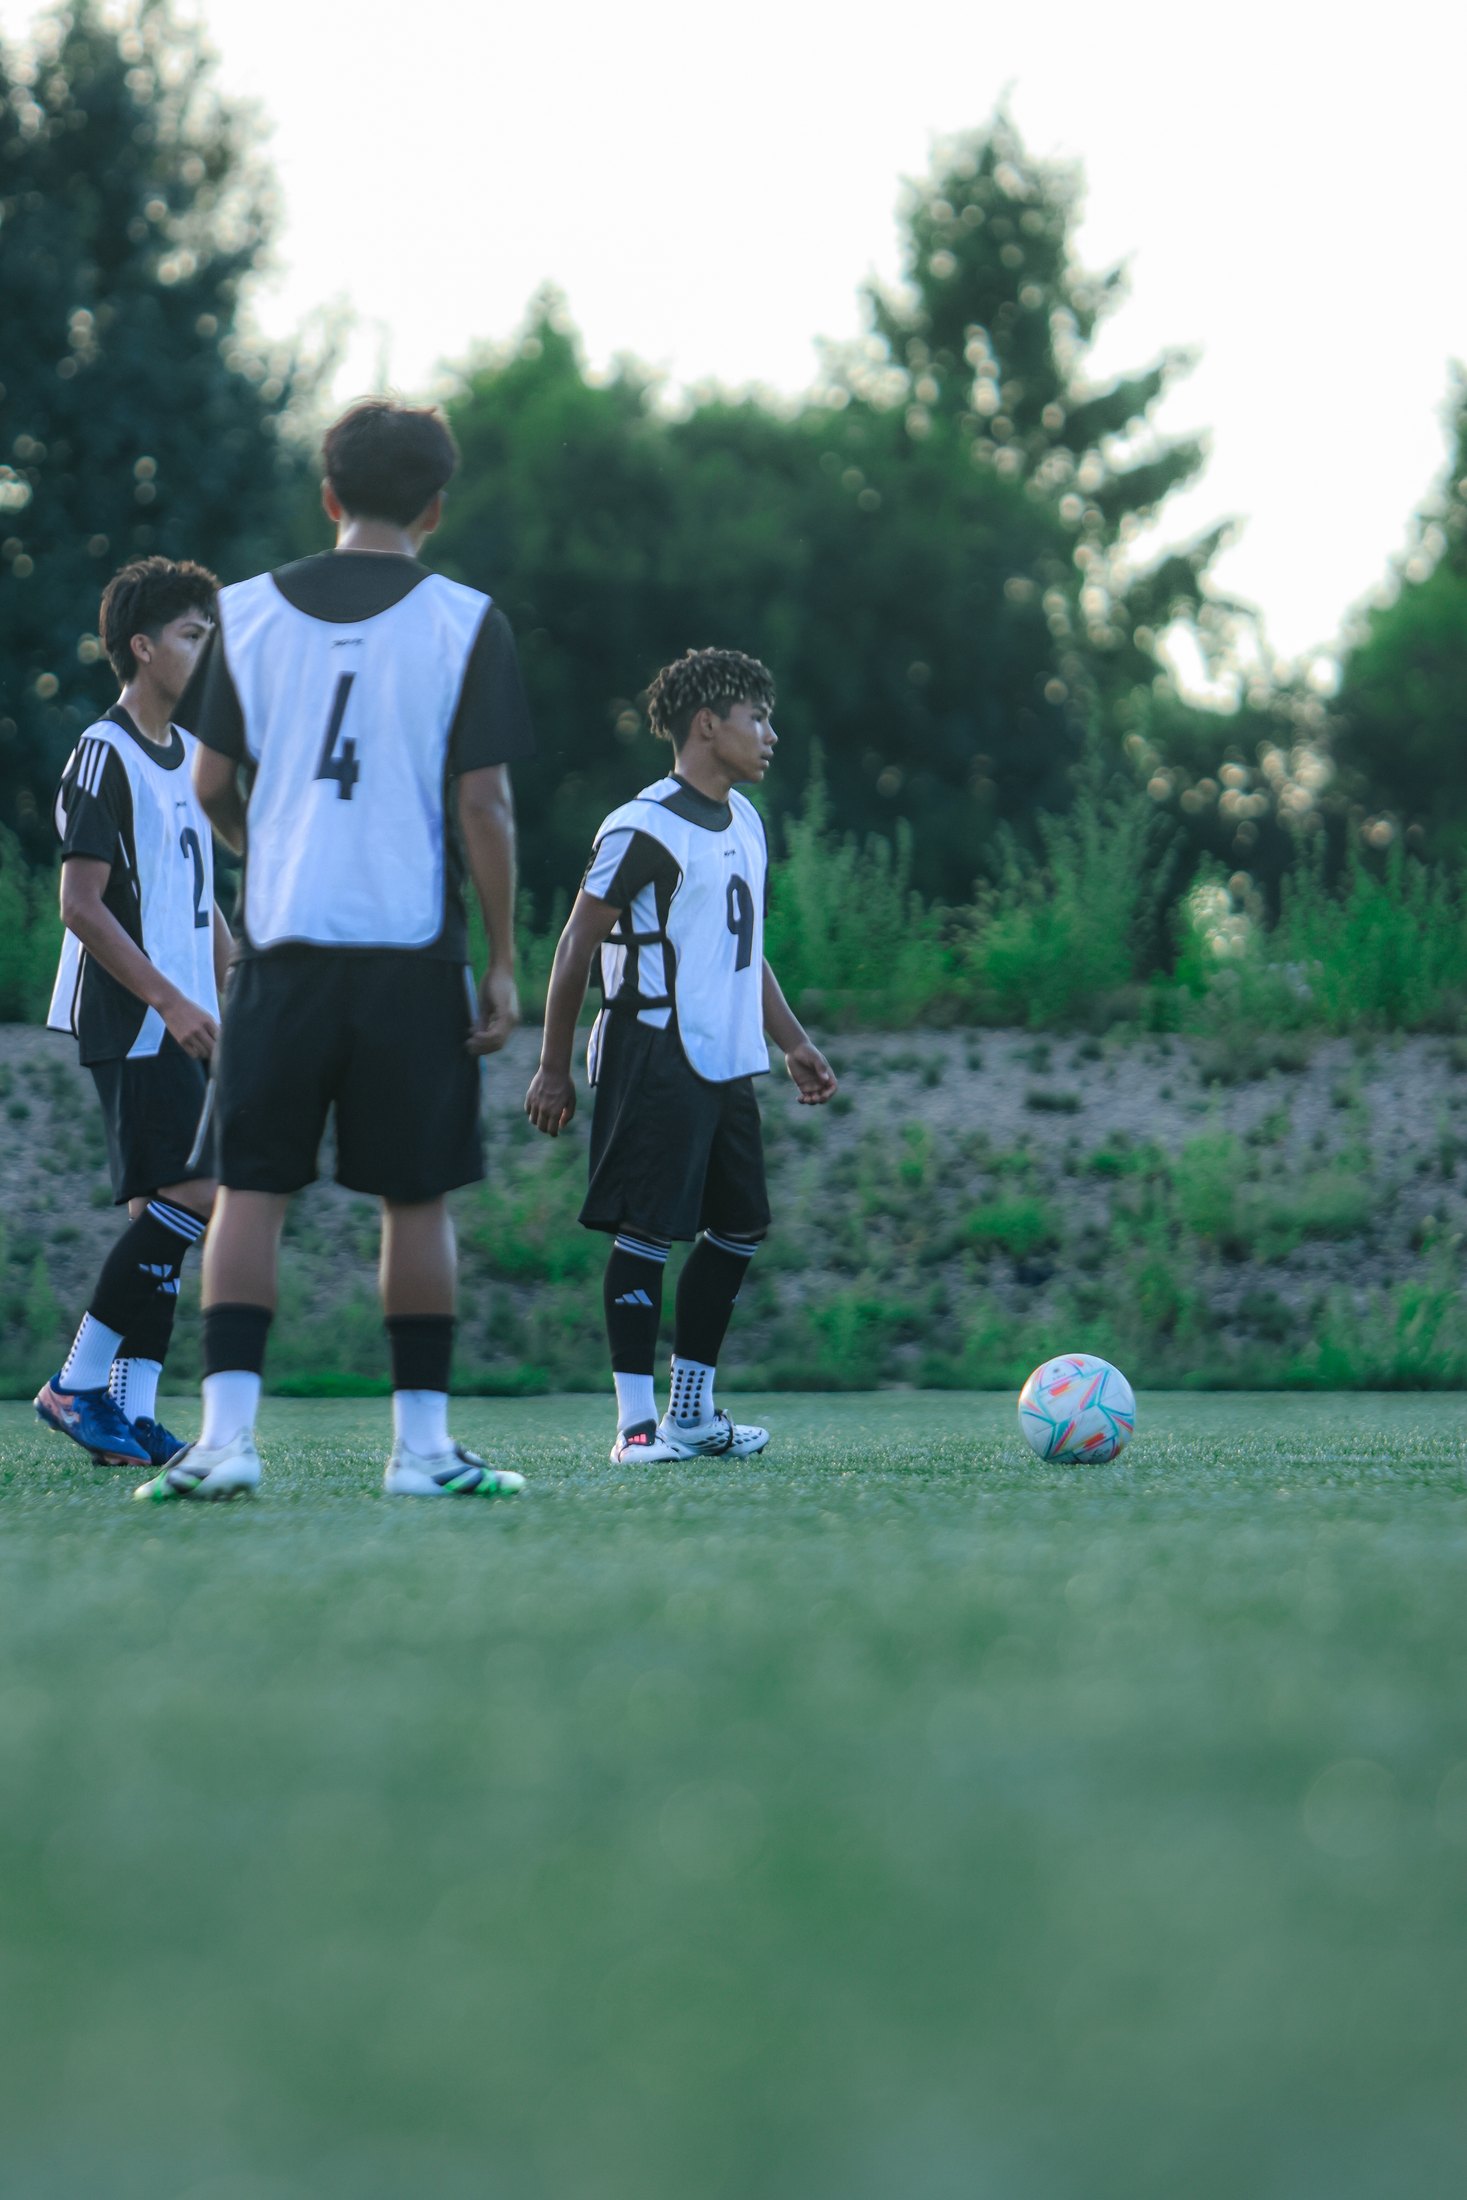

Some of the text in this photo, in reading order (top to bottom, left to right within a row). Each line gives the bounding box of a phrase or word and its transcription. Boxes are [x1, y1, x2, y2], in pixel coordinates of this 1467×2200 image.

[314, 671, 360, 800] 4
[180, 827, 209, 928] 2
[726, 874, 754, 972] 9
